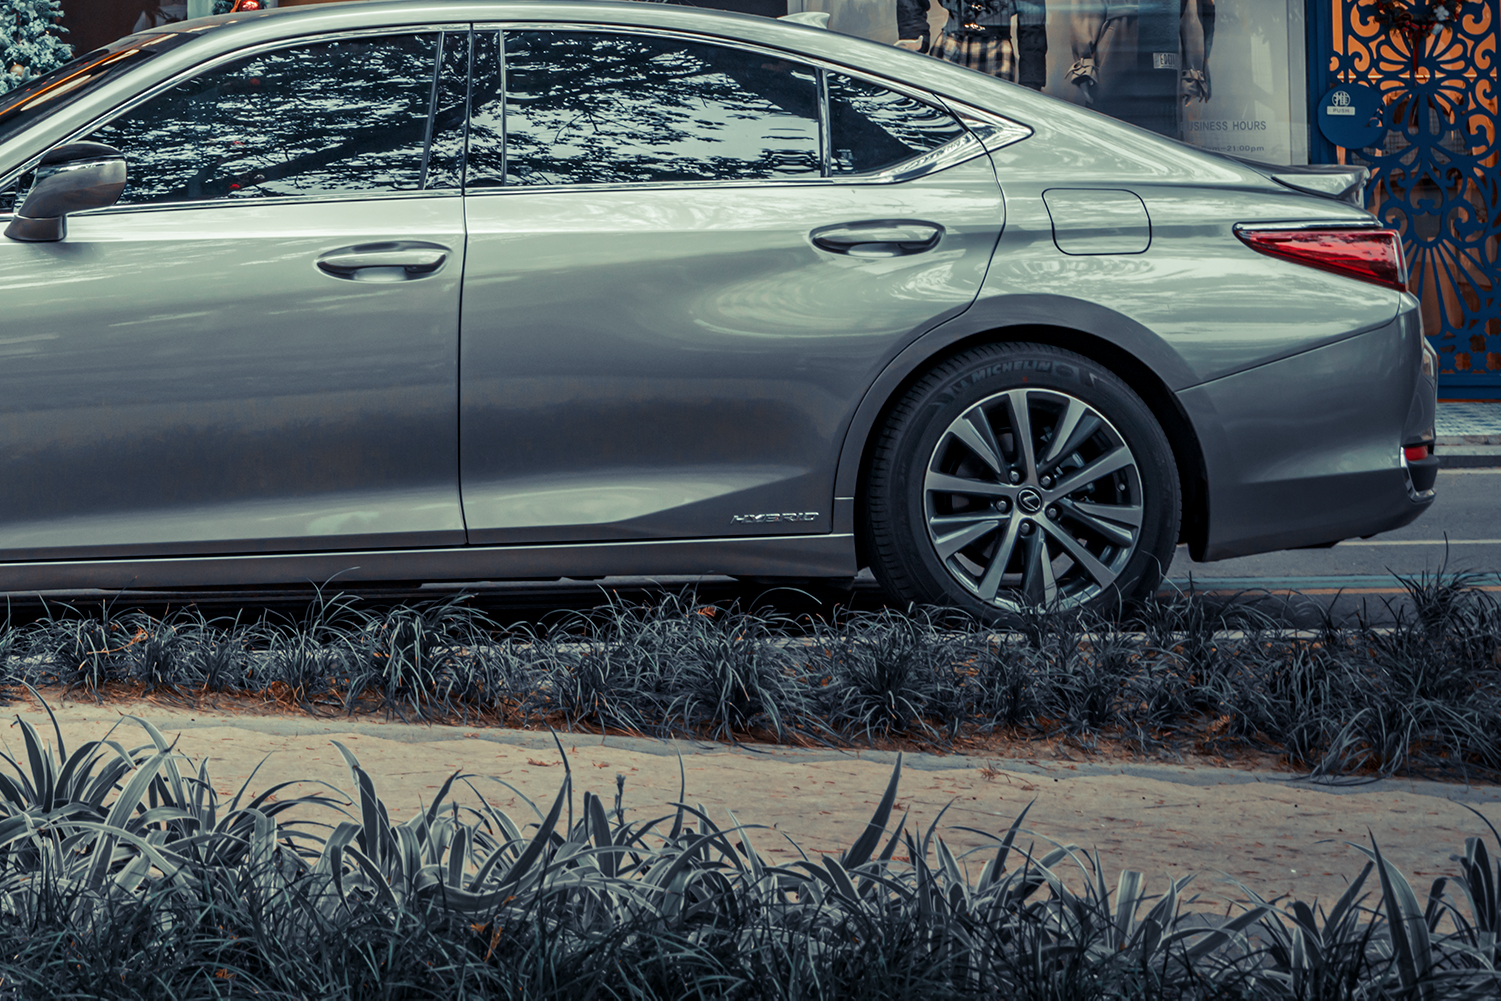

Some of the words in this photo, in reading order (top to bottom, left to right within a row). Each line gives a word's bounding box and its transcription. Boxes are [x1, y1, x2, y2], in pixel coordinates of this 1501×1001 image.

[1232, 121, 1267, 131] HOURS
[971, 360, 1051, 383] MICHELIN
[729, 511, 820, 525] HYBRID
